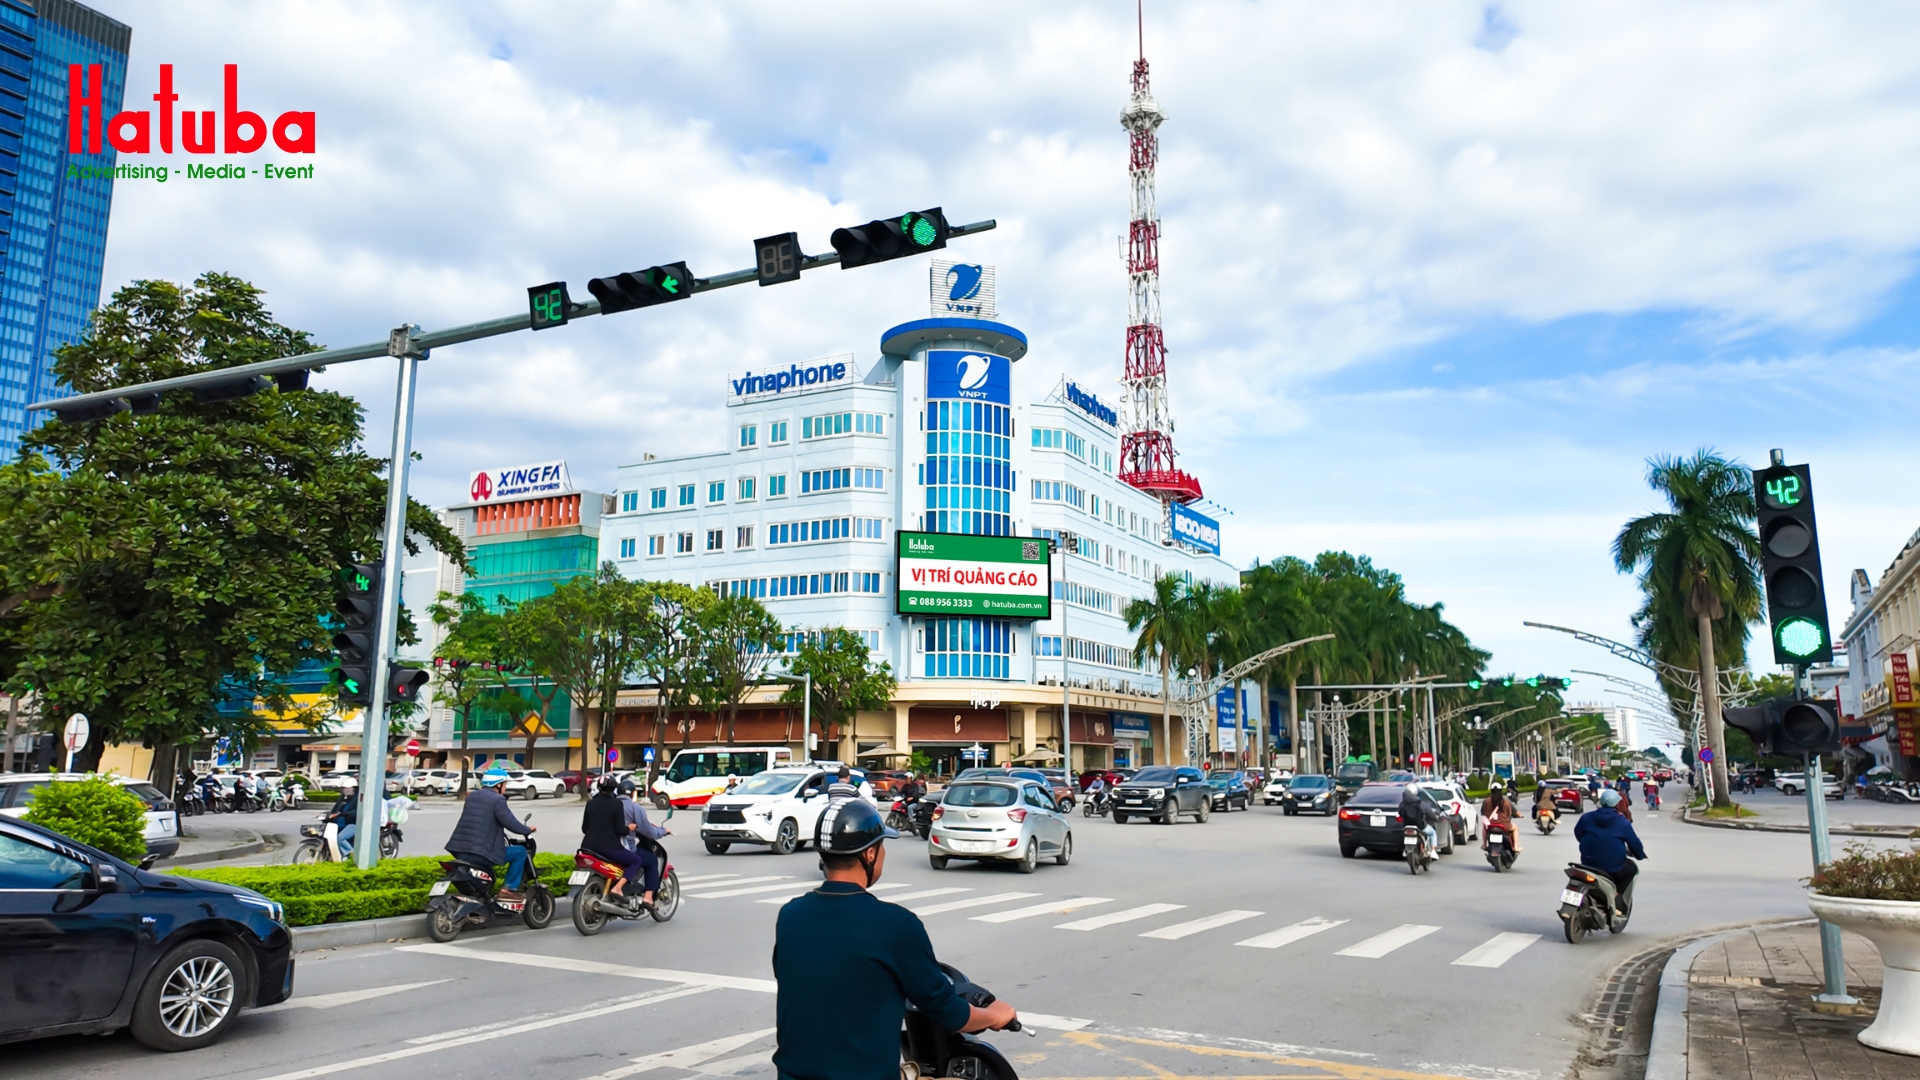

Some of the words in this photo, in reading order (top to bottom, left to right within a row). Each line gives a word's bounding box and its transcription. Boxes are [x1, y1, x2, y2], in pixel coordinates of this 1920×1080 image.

[534, 289, 562, 321] 42
[946, 303, 982, 314] VNPT
[732, 363, 846, 396] vinaphone
[958, 390, 987, 399] VNPT
[1066, 382, 1117, 427] vinaphone
[497, 465, 560, 487] XINGFA
[1766, 475, 1800, 504] 42
[908, 538, 935, 550] Hatuba
[911, 567, 926, 586] VỊ
[928, 566, 951, 583] TRÍ
[954, 566, 1005, 585] QUẢNG
[1008, 570, 1038, 586] CÁO
[919, 597, 935, 606] 088
[936, 598, 952, 607] 956
[952, 598, 973, 608] 3333
[991, 600, 1042, 609] hatuba.com.vn
